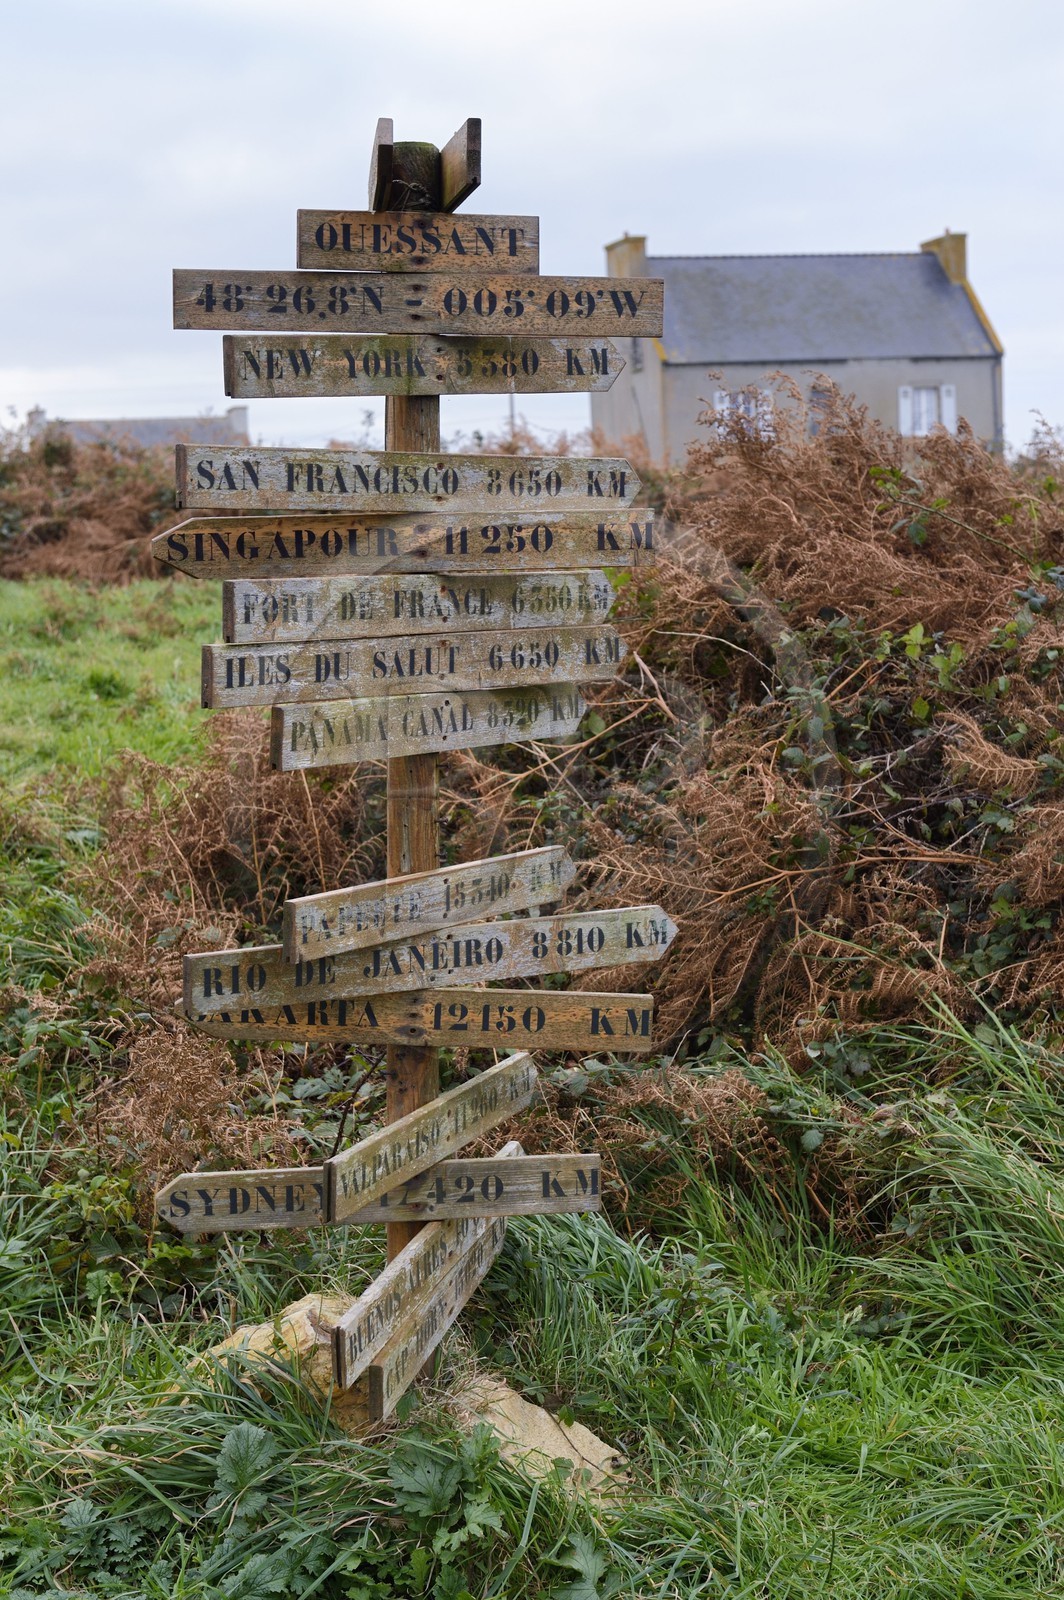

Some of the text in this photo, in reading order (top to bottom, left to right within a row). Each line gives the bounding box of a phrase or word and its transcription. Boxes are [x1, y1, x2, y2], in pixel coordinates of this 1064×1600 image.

[314, 221, 525, 257] OUESSANT
[242, 349, 320, 381] NEW
[343, 348, 427, 379] YORK
[565, 348, 609, 376] KM
[196, 459, 262, 491] SAN
[286, 462, 459, 496] FRANCISCO
[586, 470, 627, 498] KM
[166, 527, 400, 563] SINGAPOUR
[597, 522, 654, 551] KM
[242, 592, 318, 625] FORT
[340, 591, 374, 621] DE
[392, 584, 493, 619] FRANCE
[224, 654, 292, 690] ILES
[314, 651, 351, 683] DU
[372, 645, 460, 680] SALUT
[584, 637, 621, 666] KM
[289, 713, 389, 753] PANAMA
[402, 702, 474, 737] CANAL
[551, 692, 580, 722] KM
[203, 963, 267, 998] RIO
[294, 956, 336, 988] DE
[363, 937, 504, 979] JANEIRO
[625, 918, 668, 949] KM
[588, 1007, 651, 1037] KM
[541, 1168, 599, 1198] KM
[349, 1291, 402, 1366] BUENOS
